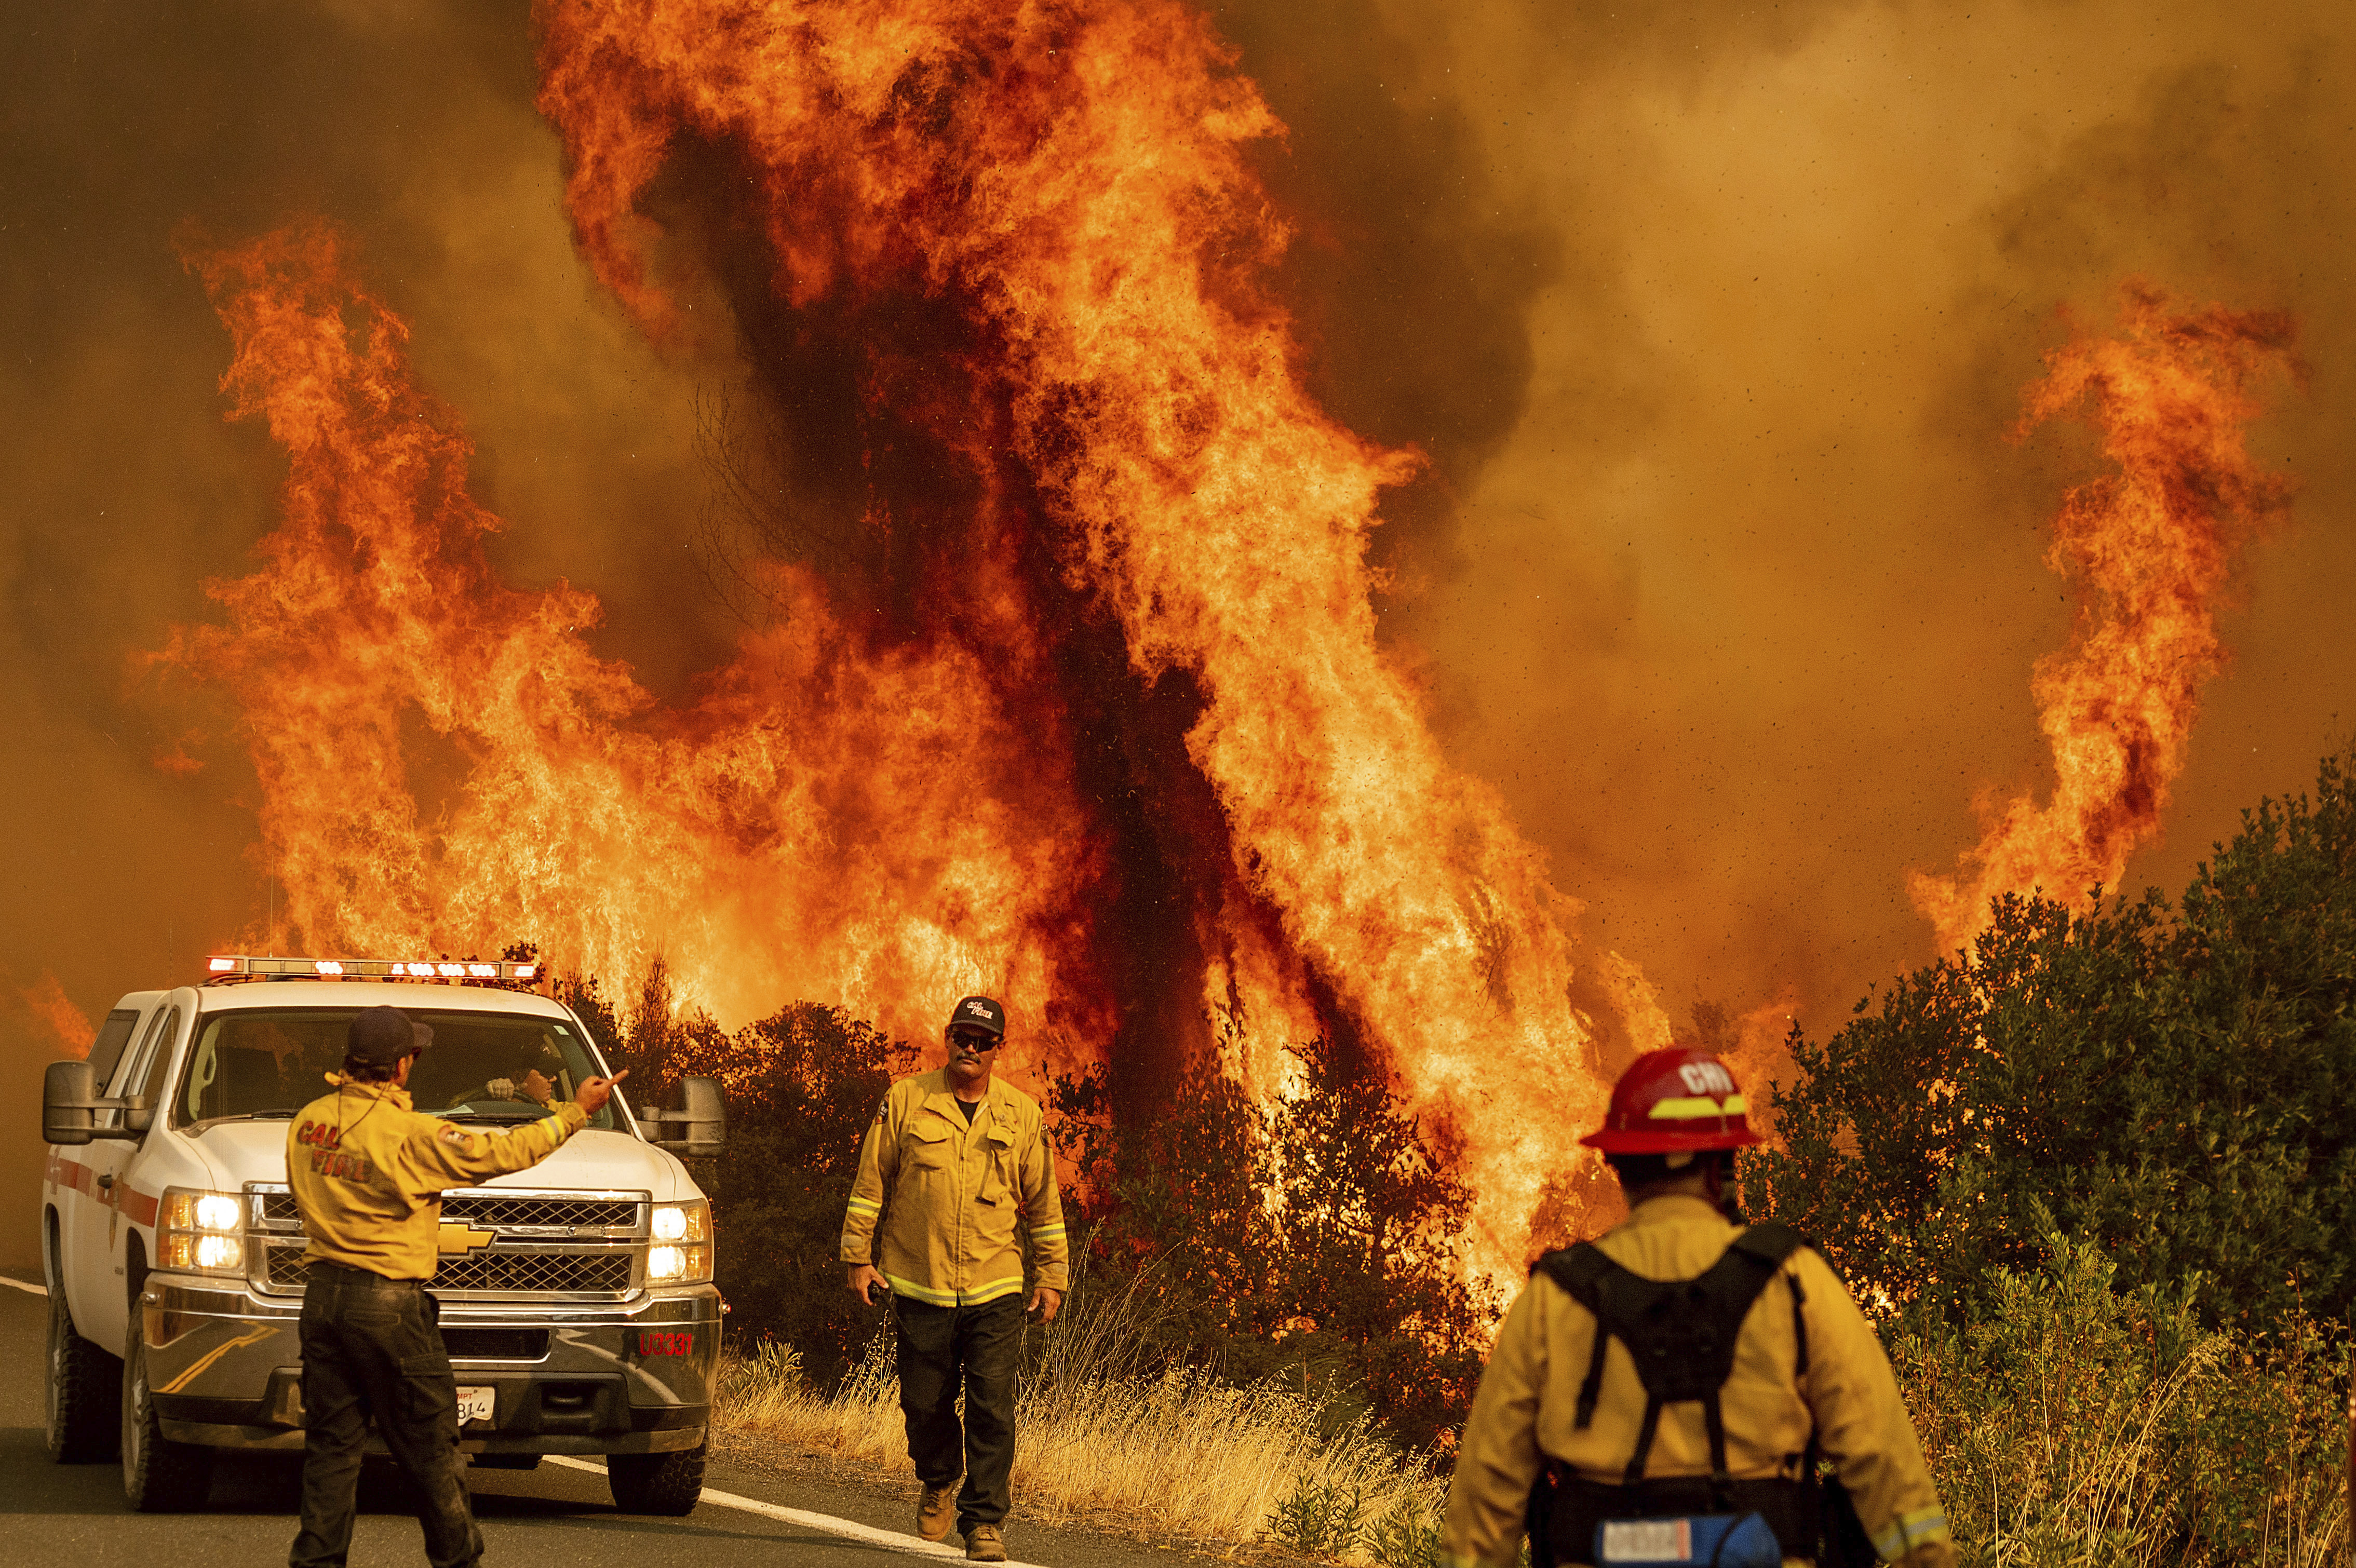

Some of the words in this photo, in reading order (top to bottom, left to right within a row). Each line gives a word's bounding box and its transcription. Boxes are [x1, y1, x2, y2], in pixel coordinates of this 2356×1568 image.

[971, 1008, 993, 1019] FIRE
[297, 1120, 341, 1151] CAL
[640, 1333, 692, 1356] U3331
